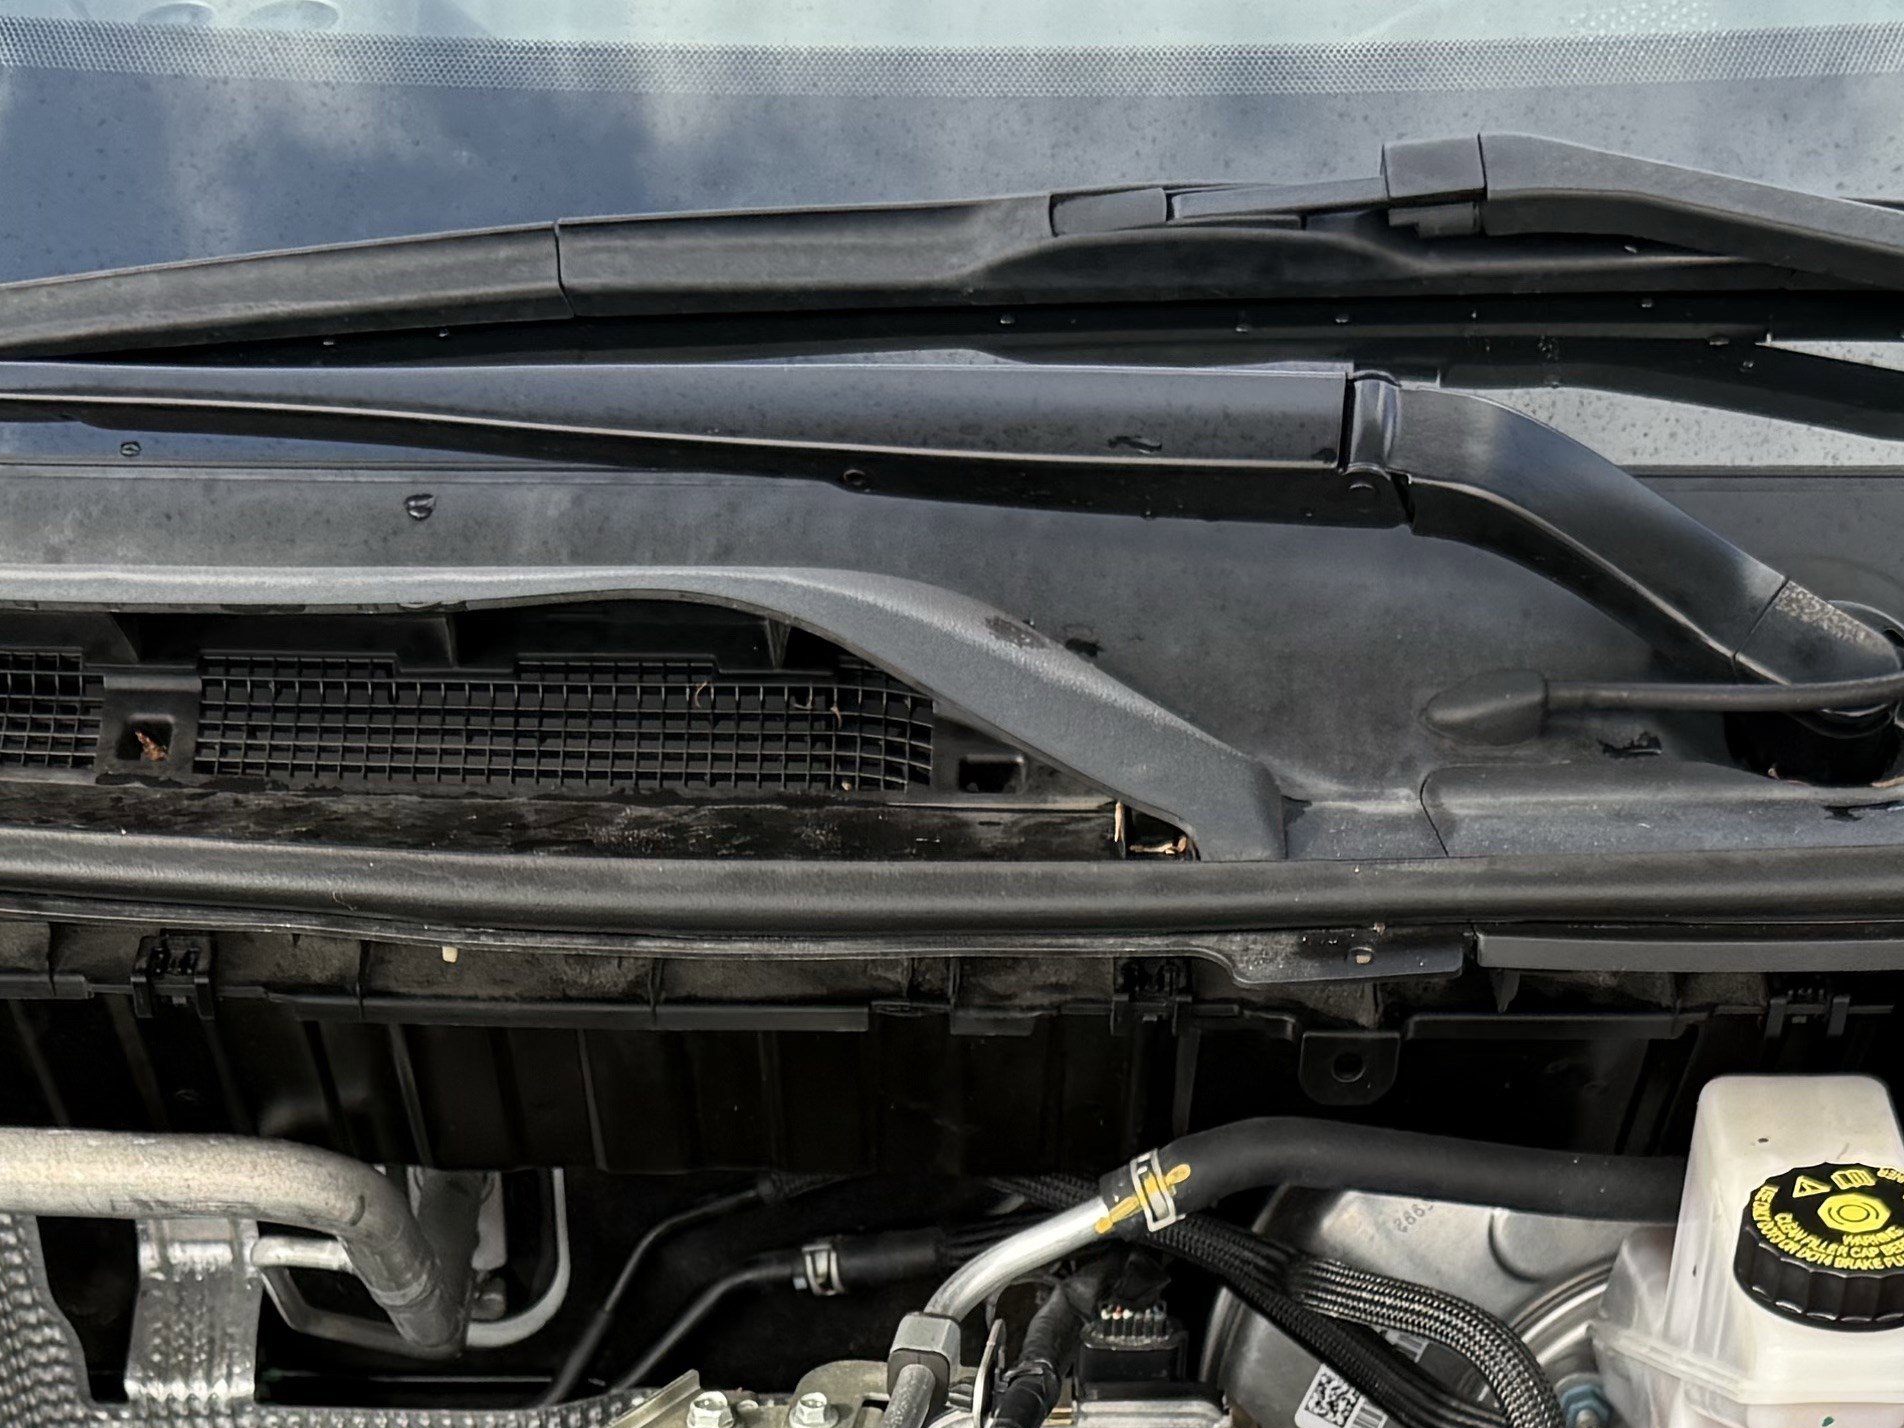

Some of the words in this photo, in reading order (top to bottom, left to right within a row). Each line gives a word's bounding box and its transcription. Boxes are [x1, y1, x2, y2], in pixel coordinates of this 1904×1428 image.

[1774, 1212, 1809, 1241] CLEAN
[1800, 1234, 1847, 1257] FILLER
[1850, 1244, 1880, 1258] CAP
[1833, 1256, 1885, 1270] BRAKE
